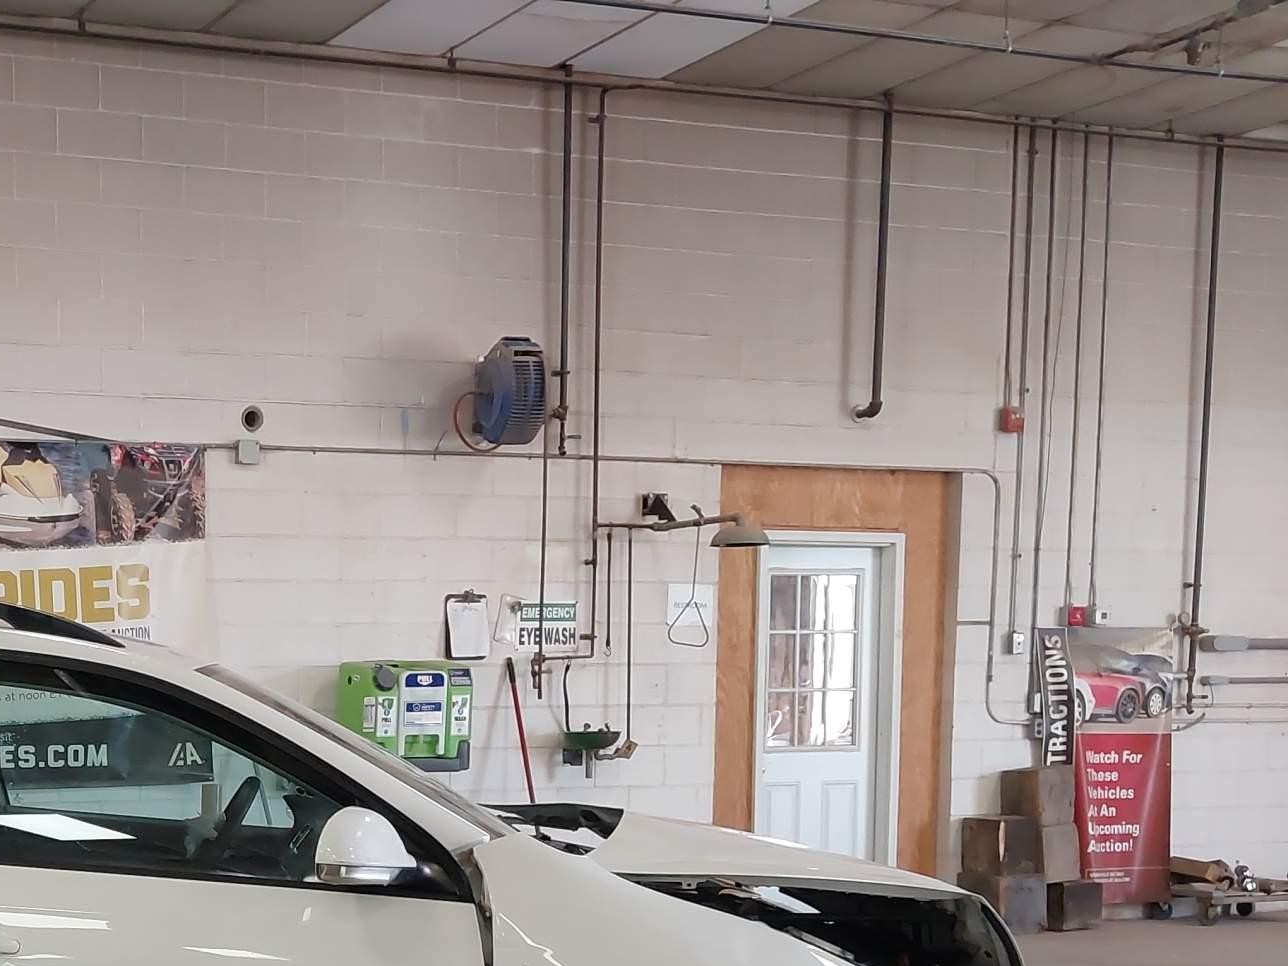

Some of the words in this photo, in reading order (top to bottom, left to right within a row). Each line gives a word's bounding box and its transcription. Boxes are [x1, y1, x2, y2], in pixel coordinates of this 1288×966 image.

[519, 627, 542, 646] EYE
[544, 627, 576, 646] WASH
[4, 692, 15, 702] at
[19, 692, 46, 701] noon
[1086, 750, 1118, 764] Watch
[1122, 750, 1142, 763] For
[1088, 786, 1134, 799] Vehicles
[1088, 805, 1097, 817] At
[1100, 804, 1116, 817] An
[1088, 822, 1140, 836] Upcoming
[1087, 839, 1133, 853] Auction!
